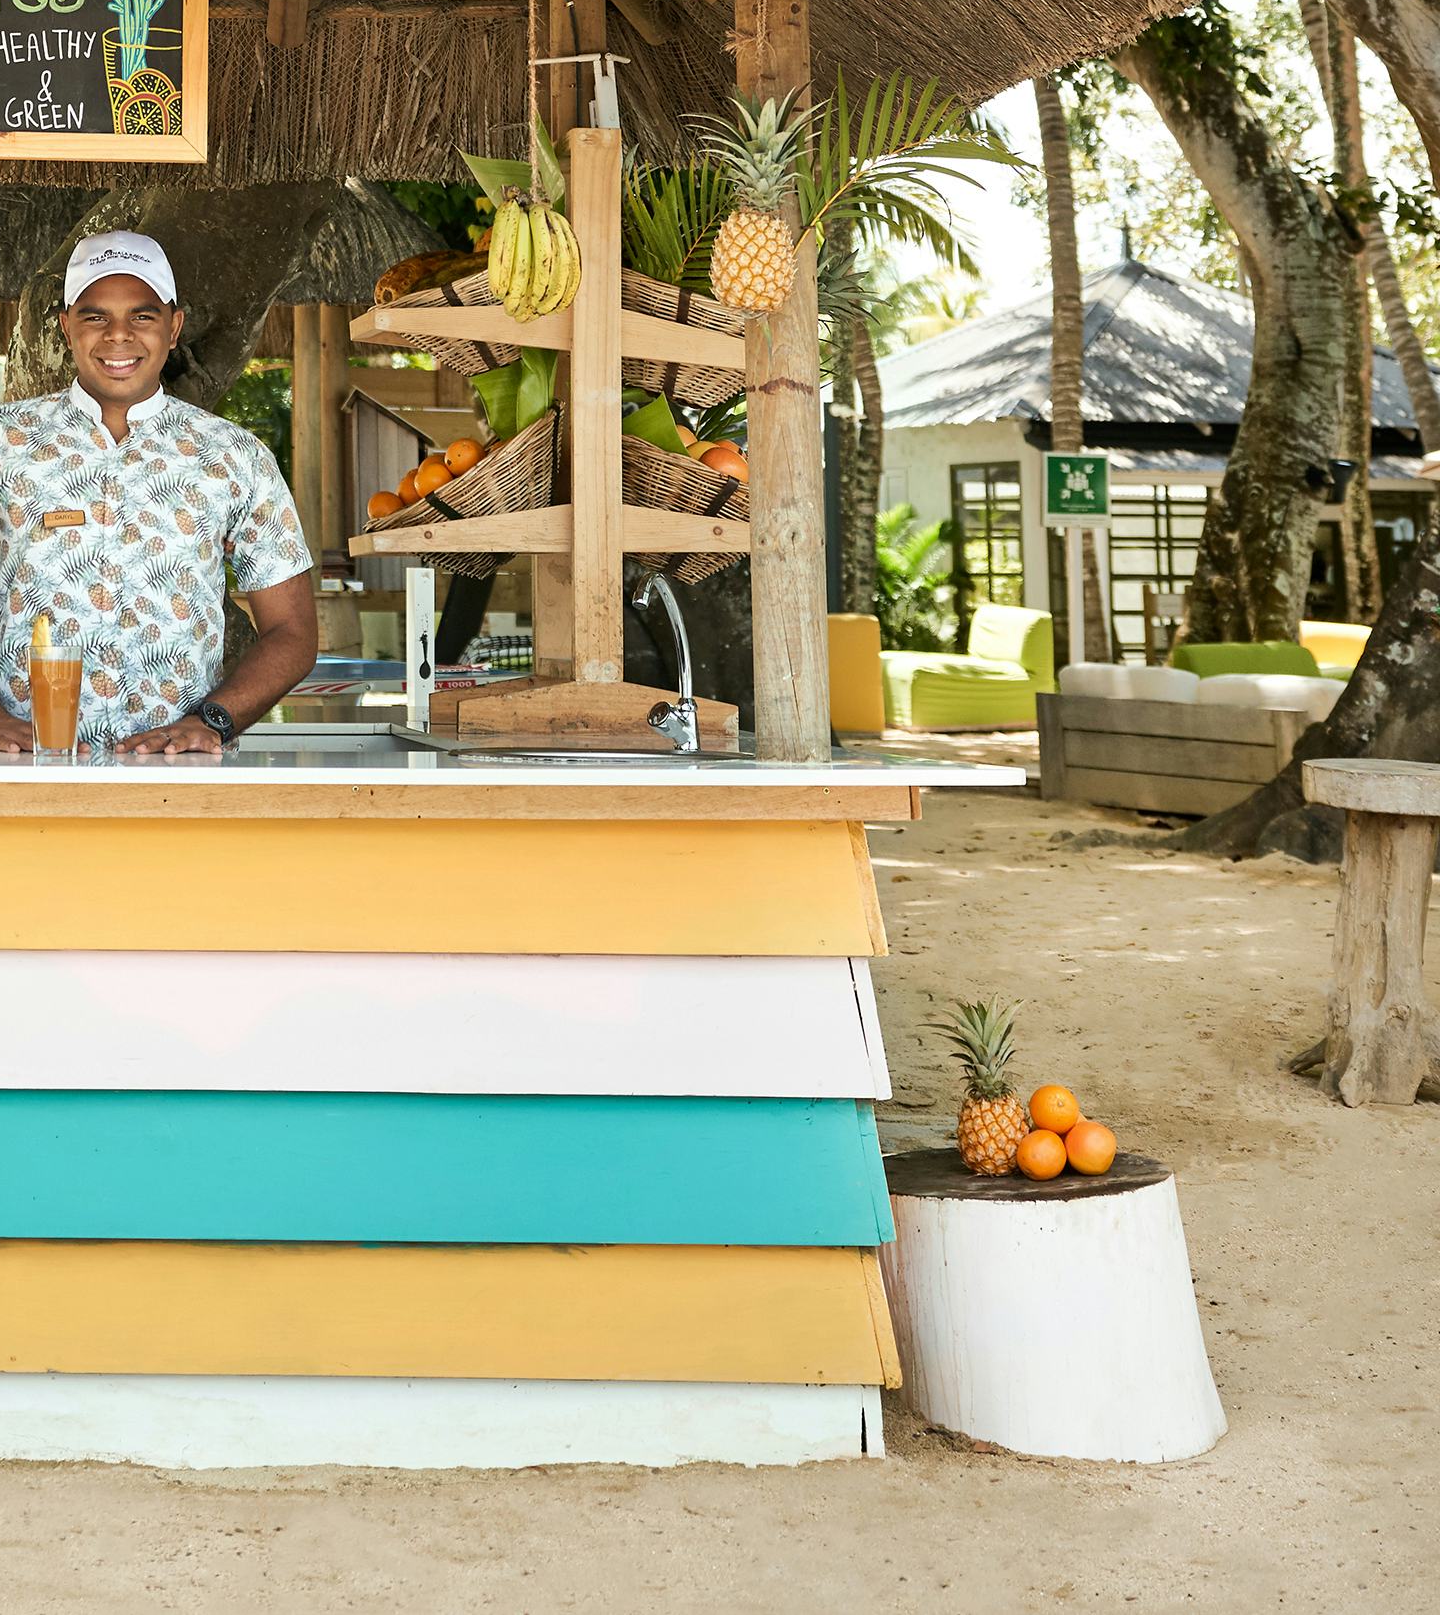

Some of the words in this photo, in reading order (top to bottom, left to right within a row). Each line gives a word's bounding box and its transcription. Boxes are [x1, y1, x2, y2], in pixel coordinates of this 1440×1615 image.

[36, 69, 53, 103] &
[4, 97, 85, 130] GREEN
[447, 681, 472, 689] 1000
